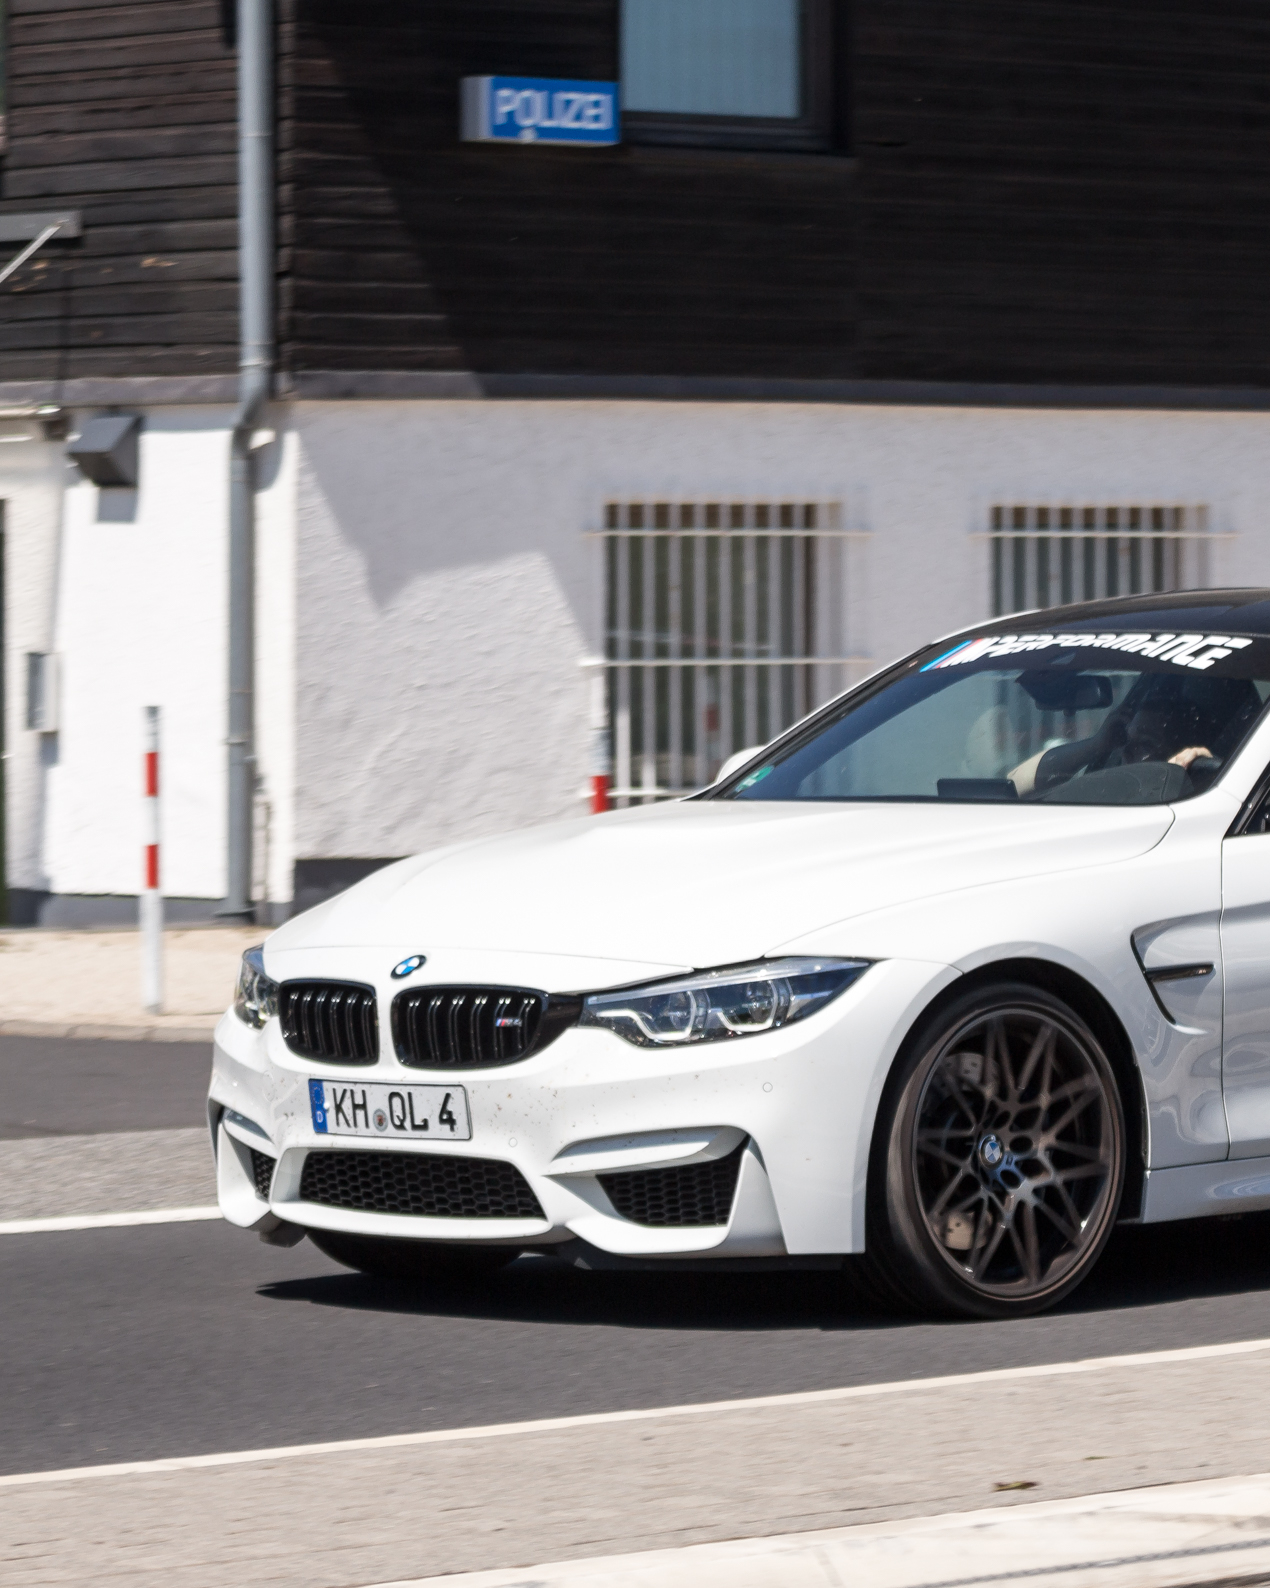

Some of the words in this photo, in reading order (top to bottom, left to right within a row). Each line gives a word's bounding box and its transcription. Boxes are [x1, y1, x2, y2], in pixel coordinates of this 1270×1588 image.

[495, 88, 613, 129] POLIZEI
[332, 1087, 370, 1129] KH
[388, 1091, 429, 1132] QL
[438, 1092, 457, 1132] 4
